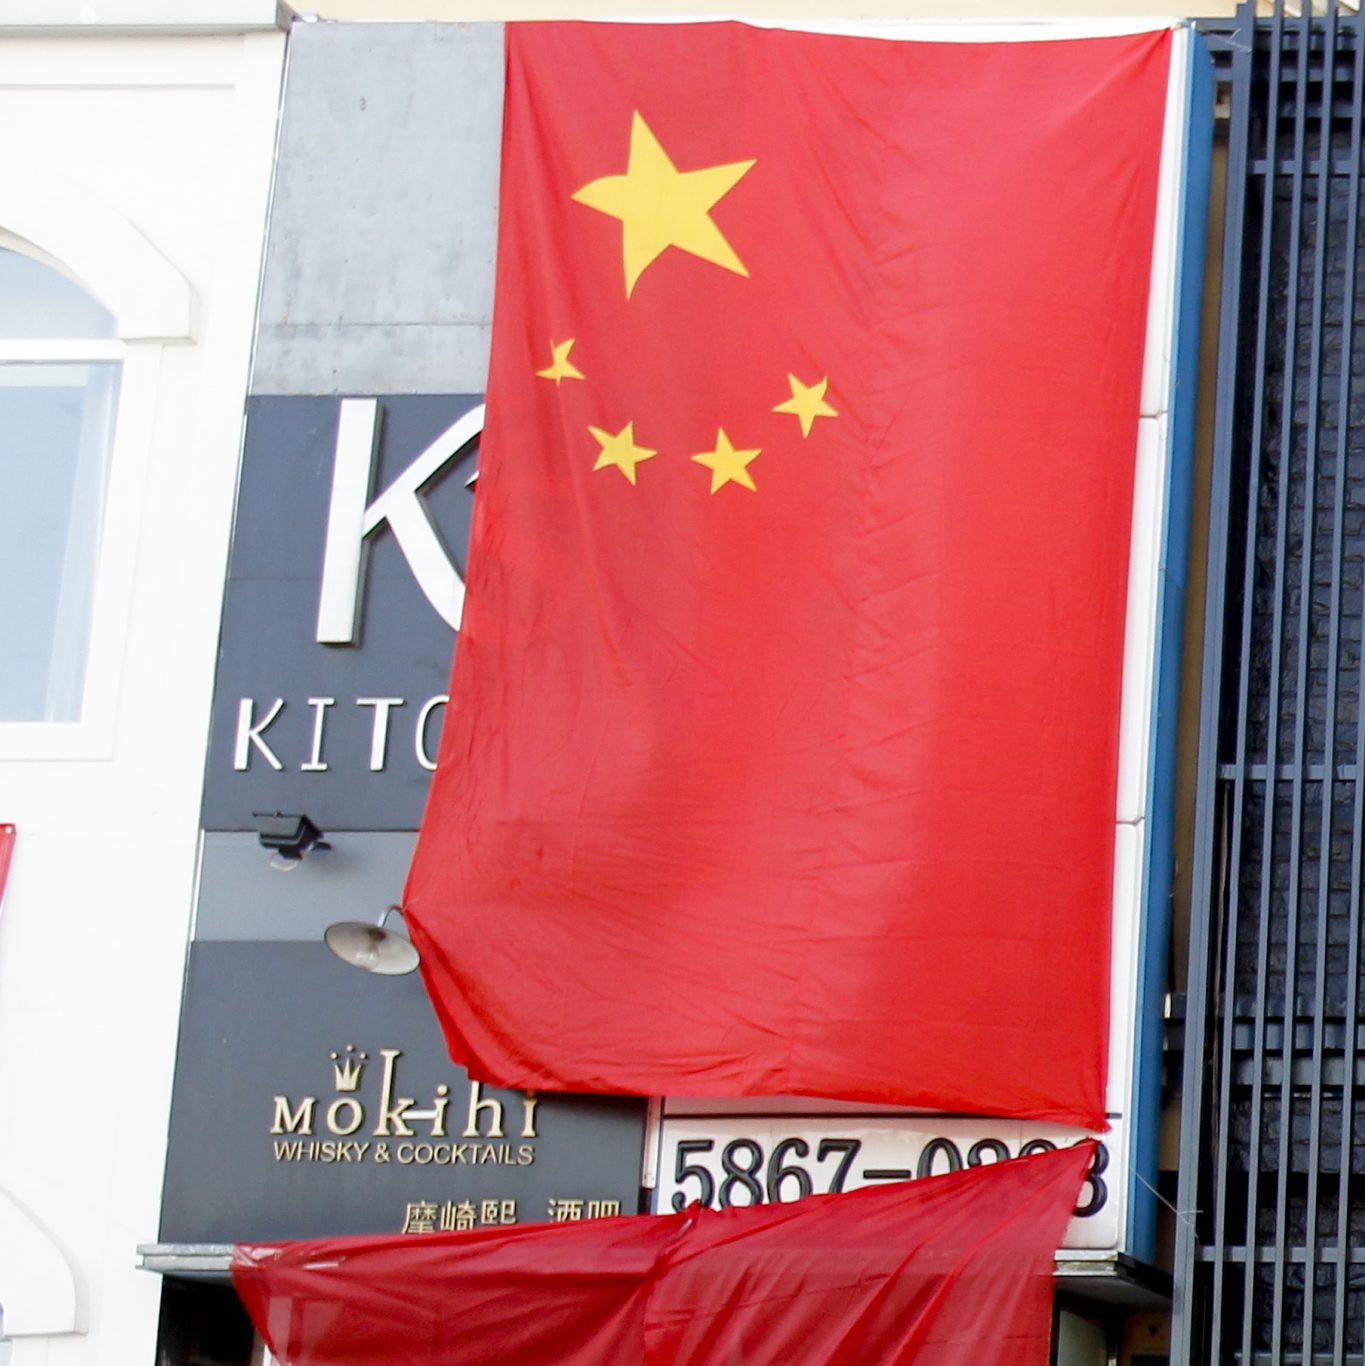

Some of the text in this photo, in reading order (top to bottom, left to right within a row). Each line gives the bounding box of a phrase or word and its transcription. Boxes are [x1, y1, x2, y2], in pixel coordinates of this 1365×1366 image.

[274, 1140, 535, 1167] WHISKY & COCKTAILS
